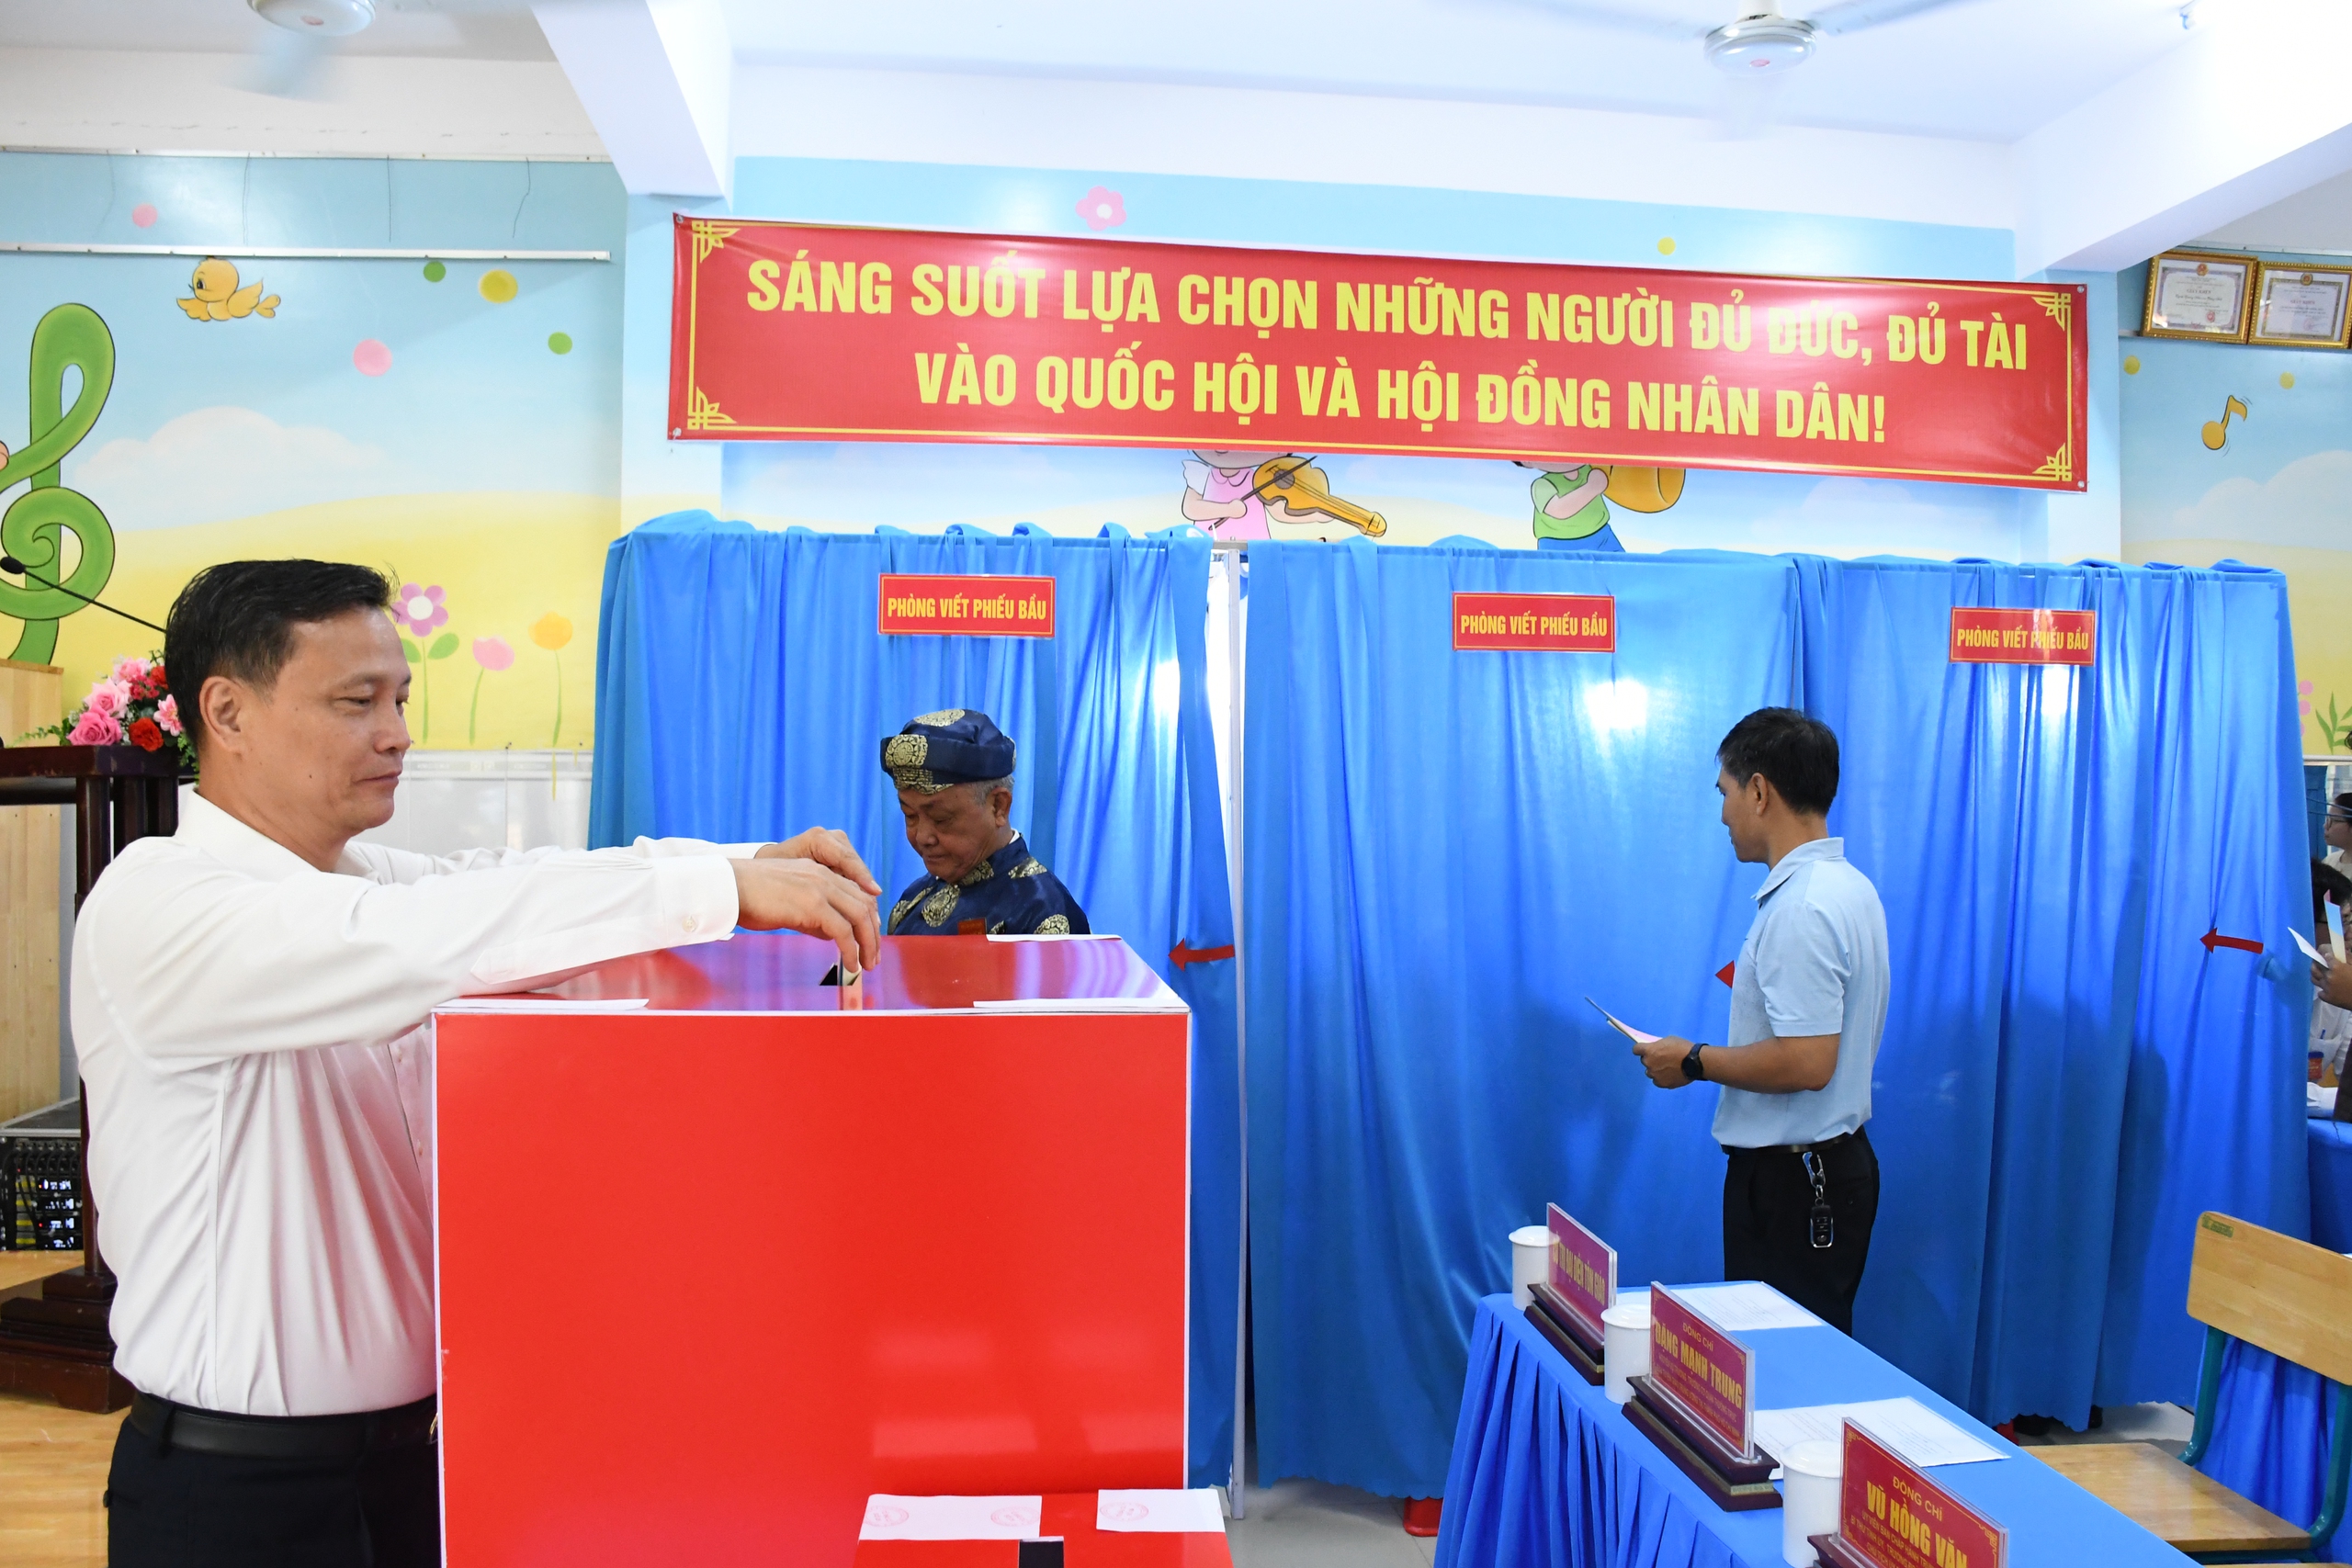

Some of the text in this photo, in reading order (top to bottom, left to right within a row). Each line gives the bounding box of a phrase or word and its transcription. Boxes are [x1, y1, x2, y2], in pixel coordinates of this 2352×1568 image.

[747, 249, 2027, 370] SÁNG SUỐT LỰA CHỌN NHỮNG NGƯỜI ĐỦ ĐỨC, ĐỦ TÀI
[915, 341, 1885, 443] VÀO QUỐC HỘI VÀ HỘI ĐỒNG NHÂN DÂN!
[888, 592, 1046, 620] PHÒNG VIẾT PHIẾU BẦU
[1460, 610, 1607, 637] PHÒNG VIẾT PHIẾU BẦU
[1957, 625, 2089, 650] PHÒNG VIẾT PHIẾU BẦU
[1680, 1339, 1708, 1382] MẠNH
[1710, 1361, 1743, 1410] TRUNG
[1866, 1480, 1886, 1520] VŨ
[1889, 1497, 1931, 1557] HỒNG
[1924, 1498, 1943, 1522] CHÍ
